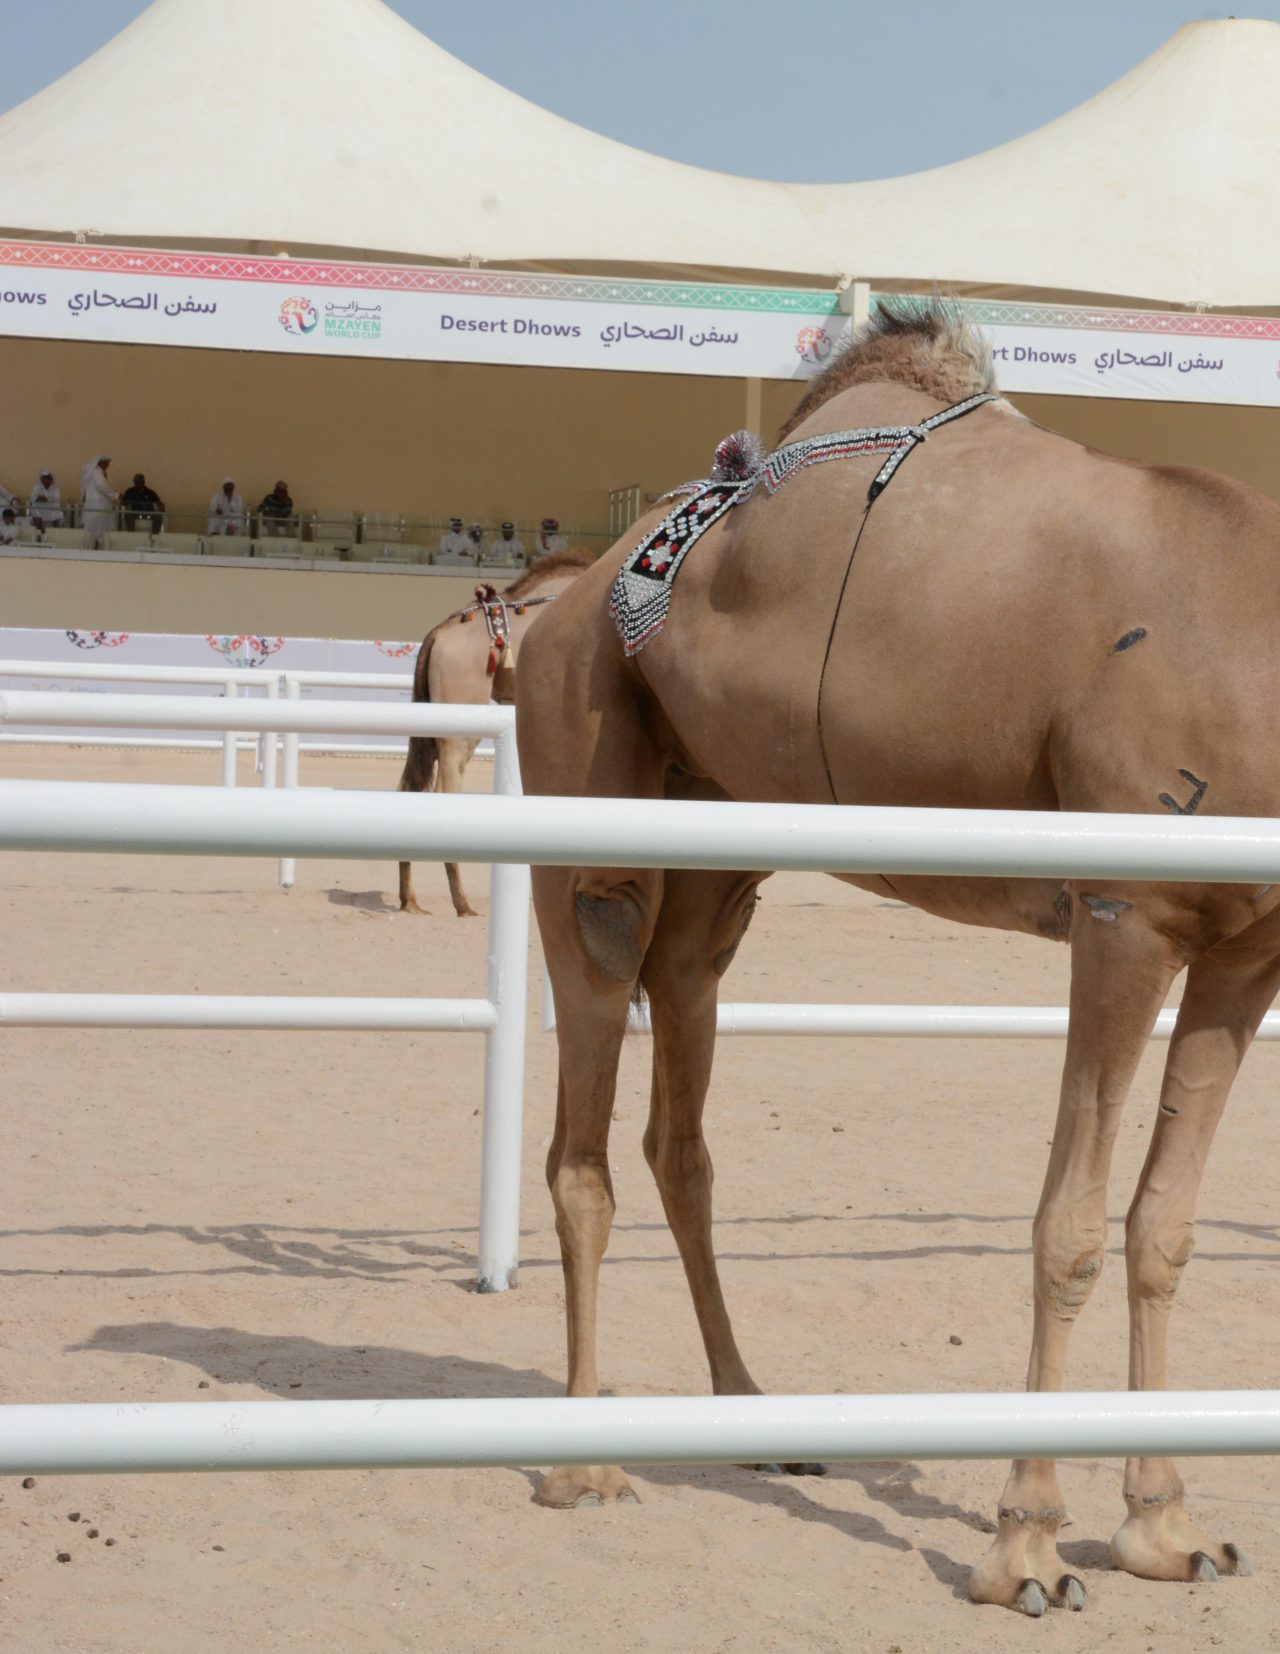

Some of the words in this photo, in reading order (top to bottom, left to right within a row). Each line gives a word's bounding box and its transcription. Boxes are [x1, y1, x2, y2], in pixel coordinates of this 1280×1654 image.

[0, 291, 47, 305] ows
[67, 289, 158, 316] الصحاري
[164, 295, 217, 316] سفن
[325, 300, 381, 312] مزاين
[325, 320, 381, 331] MZAYEN
[325, 330, 359, 338] WORLD
[440, 315, 508, 333] Desert
[513, 319, 581, 337] Dhows
[600, 322, 684, 347] الصحاري
[689, 326, 738, 346] سفن
[1013, 346, 1077, 364] Dhows
[1094, 349, 1173, 374] الصحاري
[1177, 353, 1224, 373] سفن
